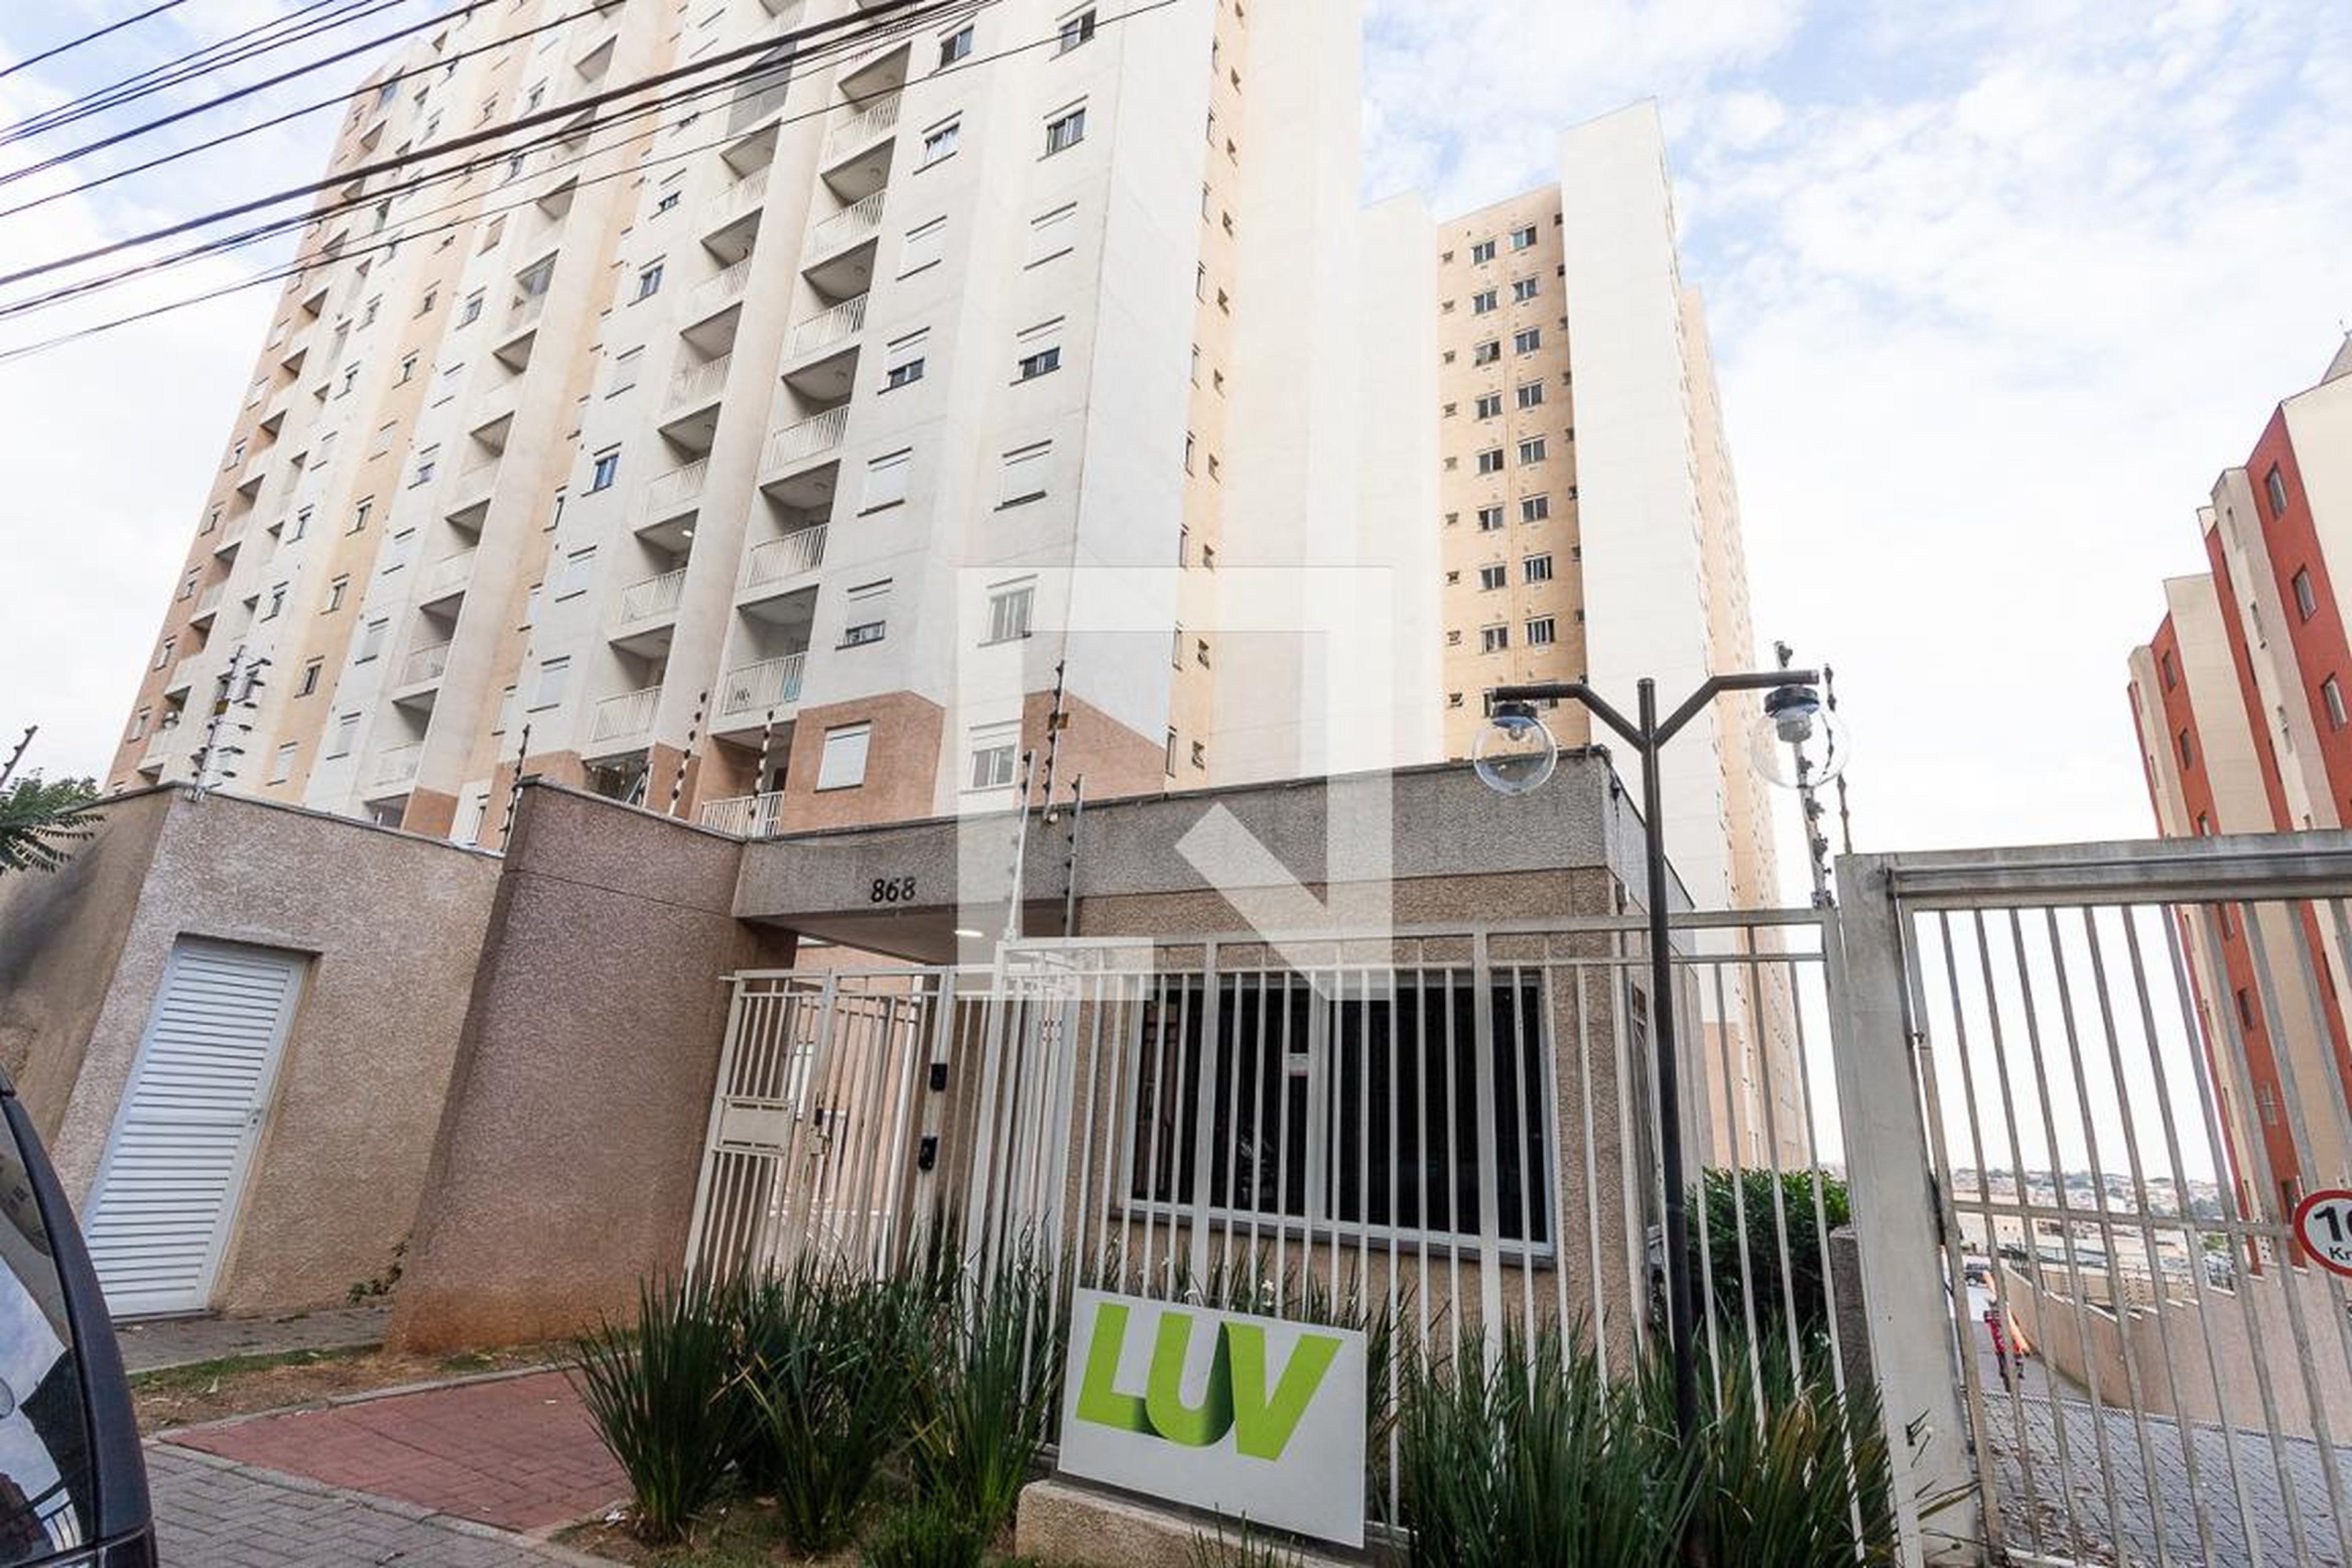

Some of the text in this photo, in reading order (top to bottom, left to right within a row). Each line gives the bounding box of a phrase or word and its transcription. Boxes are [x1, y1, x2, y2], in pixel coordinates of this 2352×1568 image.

[871, 876, 916, 902] 868
[2313, 1206, 2352, 1242] 1
[2329, 1246, 2352, 1260] K
[1076, 1302, 1343, 1461] LUV
